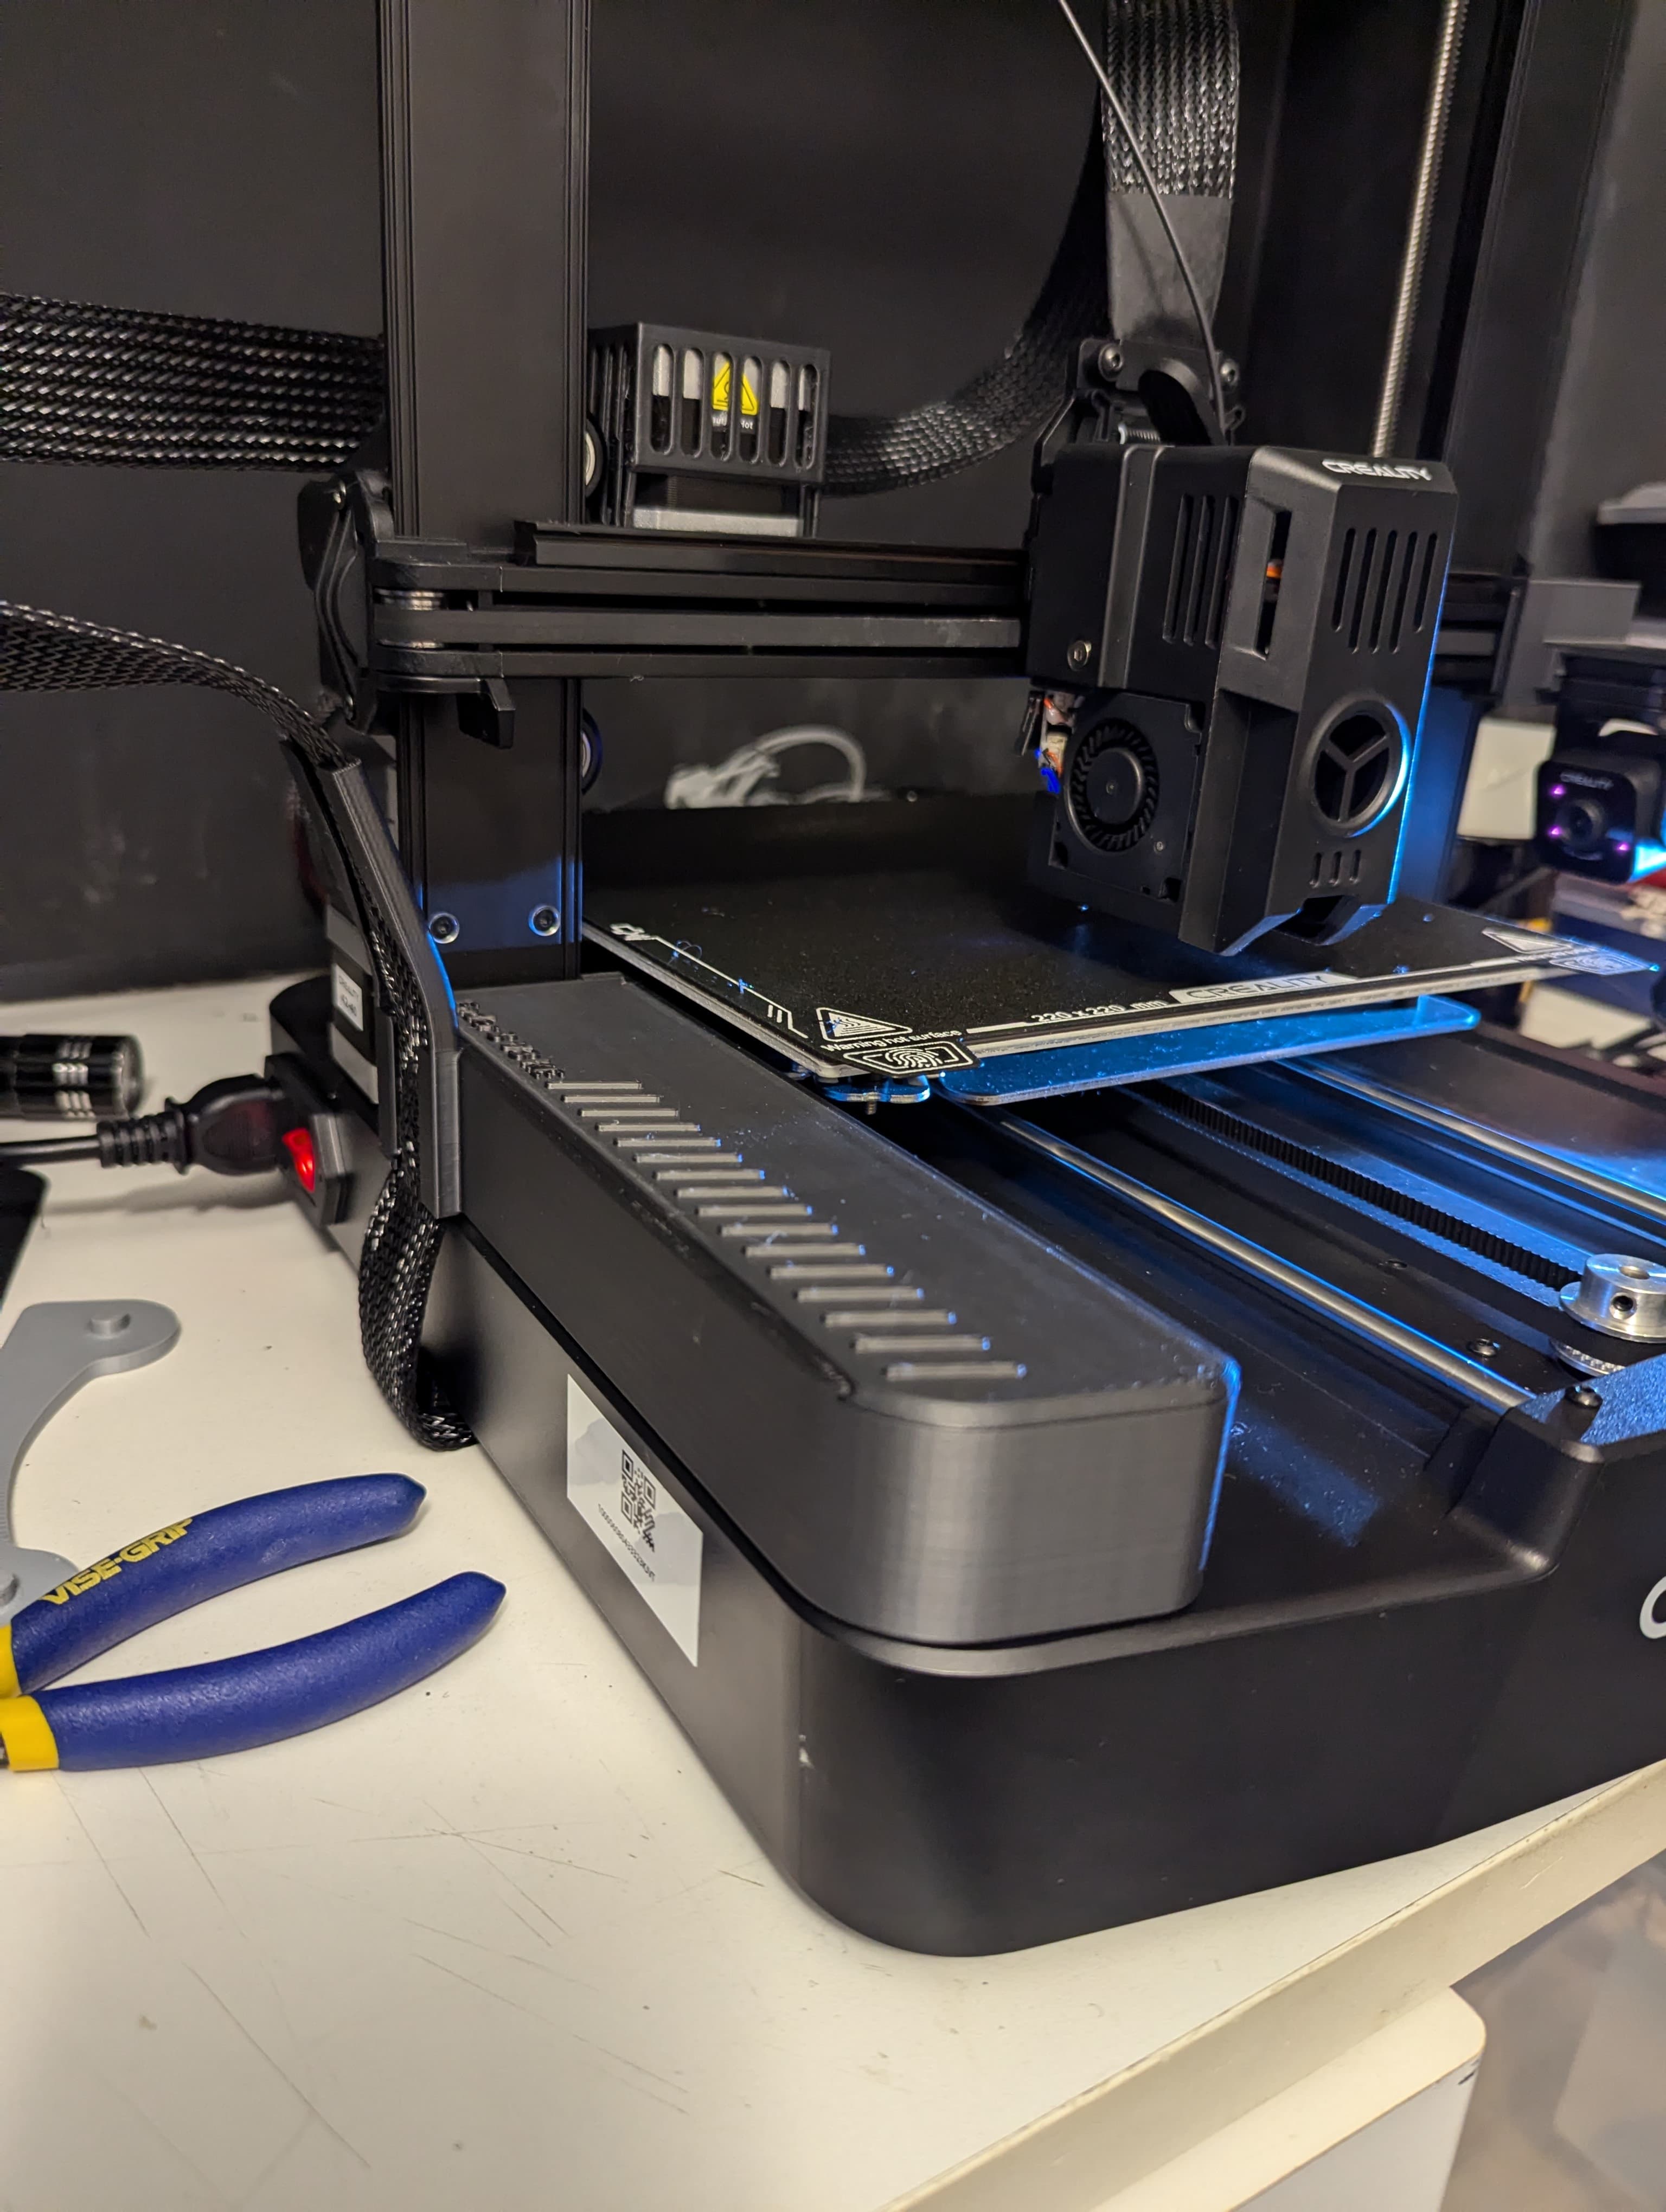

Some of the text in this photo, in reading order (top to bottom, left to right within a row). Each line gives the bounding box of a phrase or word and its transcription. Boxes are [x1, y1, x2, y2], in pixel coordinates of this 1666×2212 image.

[1322, 459, 1432, 481] CREALITY
[1186, 975, 1328, 999] CREALITY
[1031, 1011, 1072, 1023] 220
[1086, 1004, 1126, 1015] 220
[820, 1030, 963, 1052] Warning hot surface
